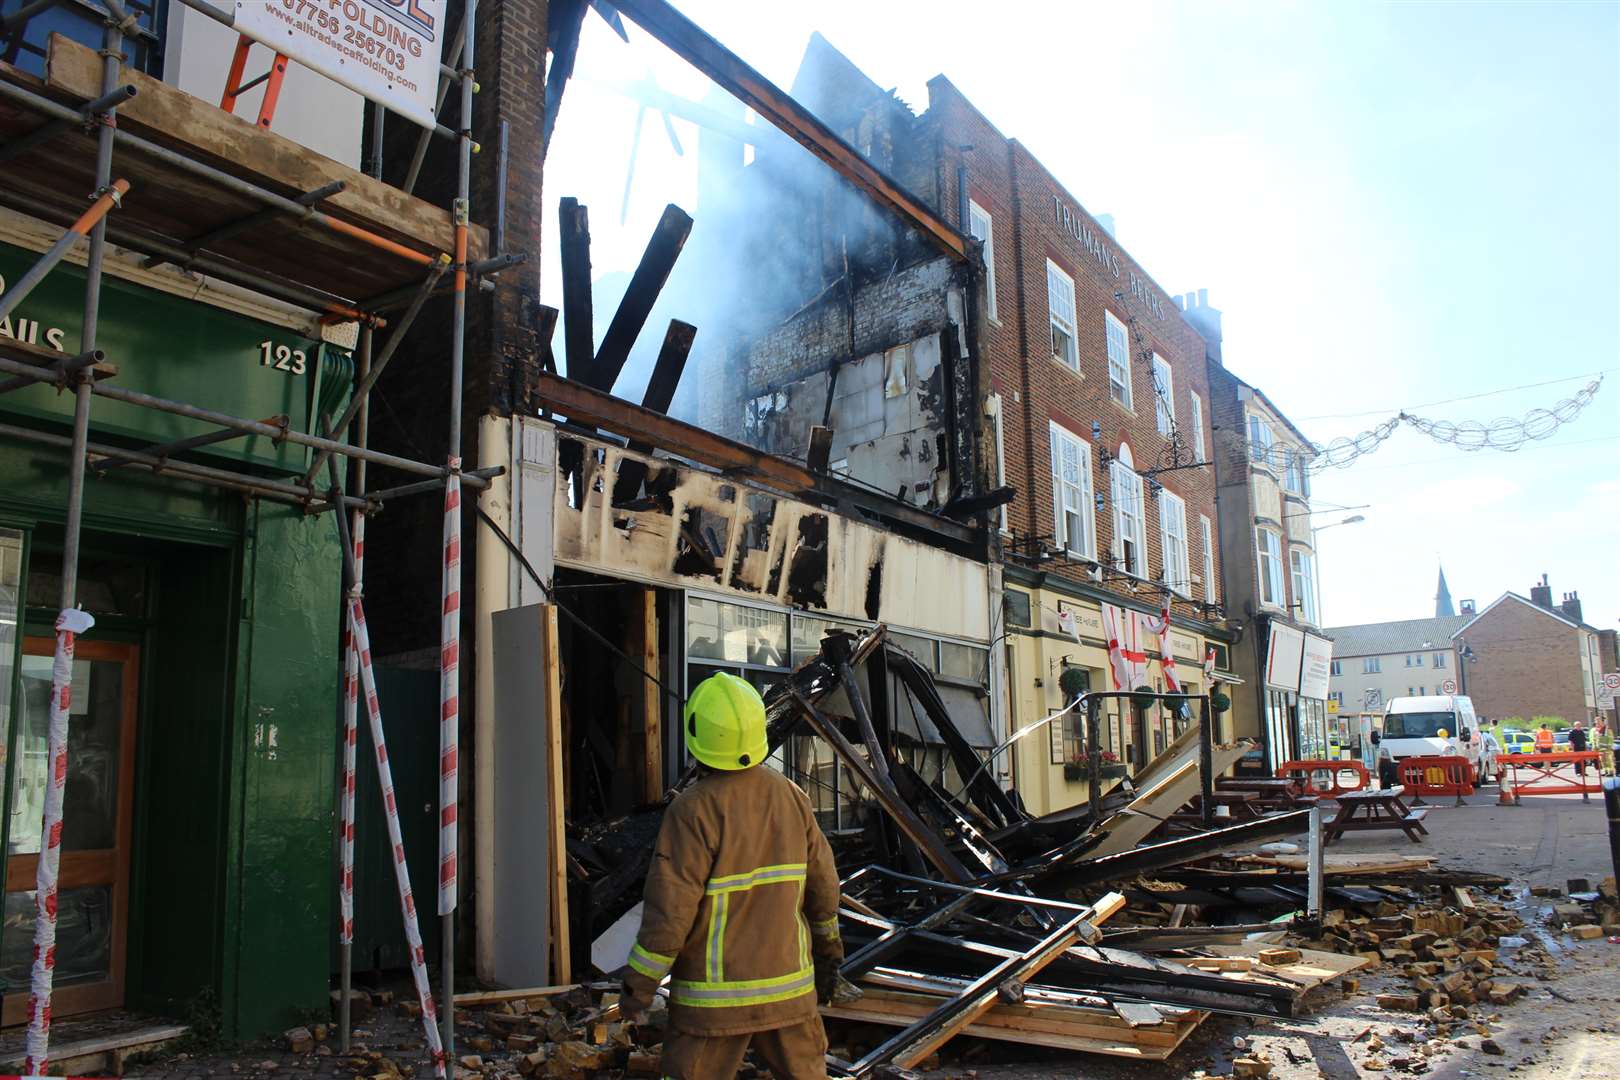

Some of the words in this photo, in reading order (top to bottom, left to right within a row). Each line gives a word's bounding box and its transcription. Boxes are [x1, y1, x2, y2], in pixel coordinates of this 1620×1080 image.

[264, 3, 418, 93] www.alltradescaffolding.com
[343, 24, 406, 71] 258703
[260, 340, 307, 375] 123
